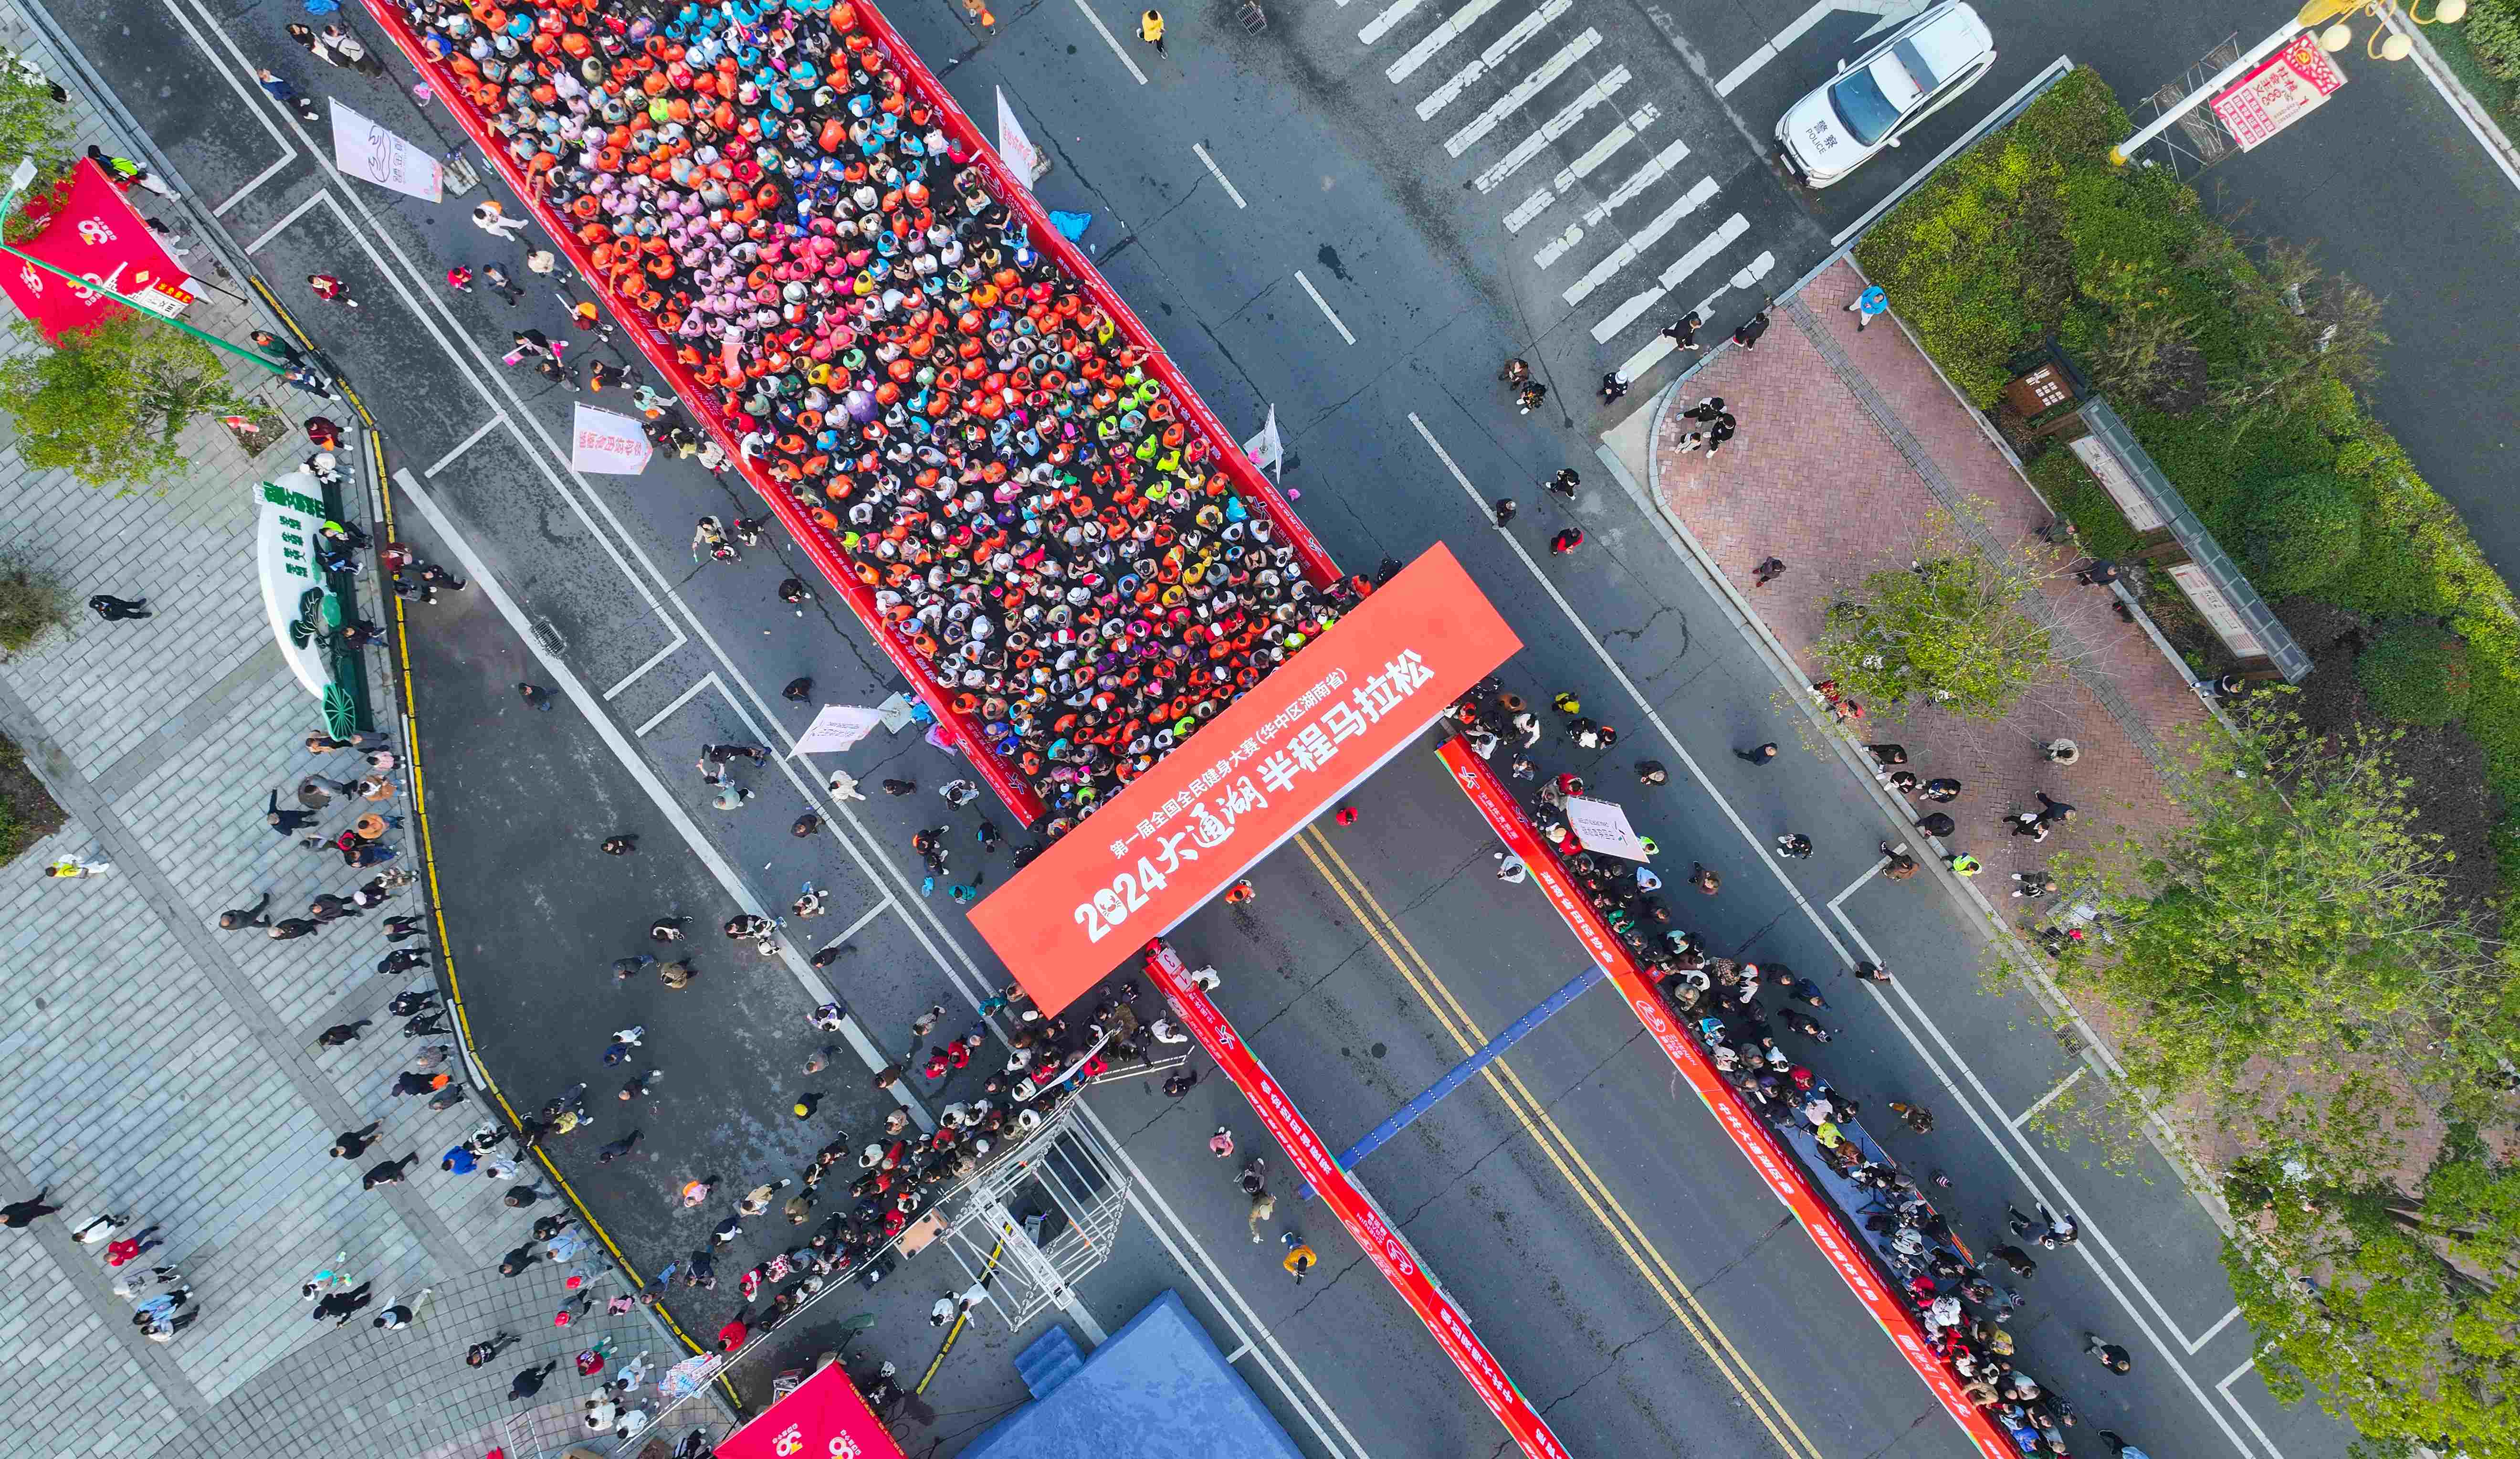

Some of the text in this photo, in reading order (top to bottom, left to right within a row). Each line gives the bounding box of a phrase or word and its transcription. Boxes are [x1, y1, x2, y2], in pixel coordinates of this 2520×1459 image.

[1806, 128, 1827, 155] POLICE
[1814, 120, 1838, 149] 警察
[1110, 668, 1347, 859] 第一届全国全民健身大赛(华中区湖南省)
[1539, 868, 1614, 964] 湖南省田径协会
[1258, 1078, 1334, 1175] 湖南省田径协会
[1715, 1100, 1795, 1196] 中共大通湖区委
[1437, 1307, 1516, 1405] 中共大通湖区委
